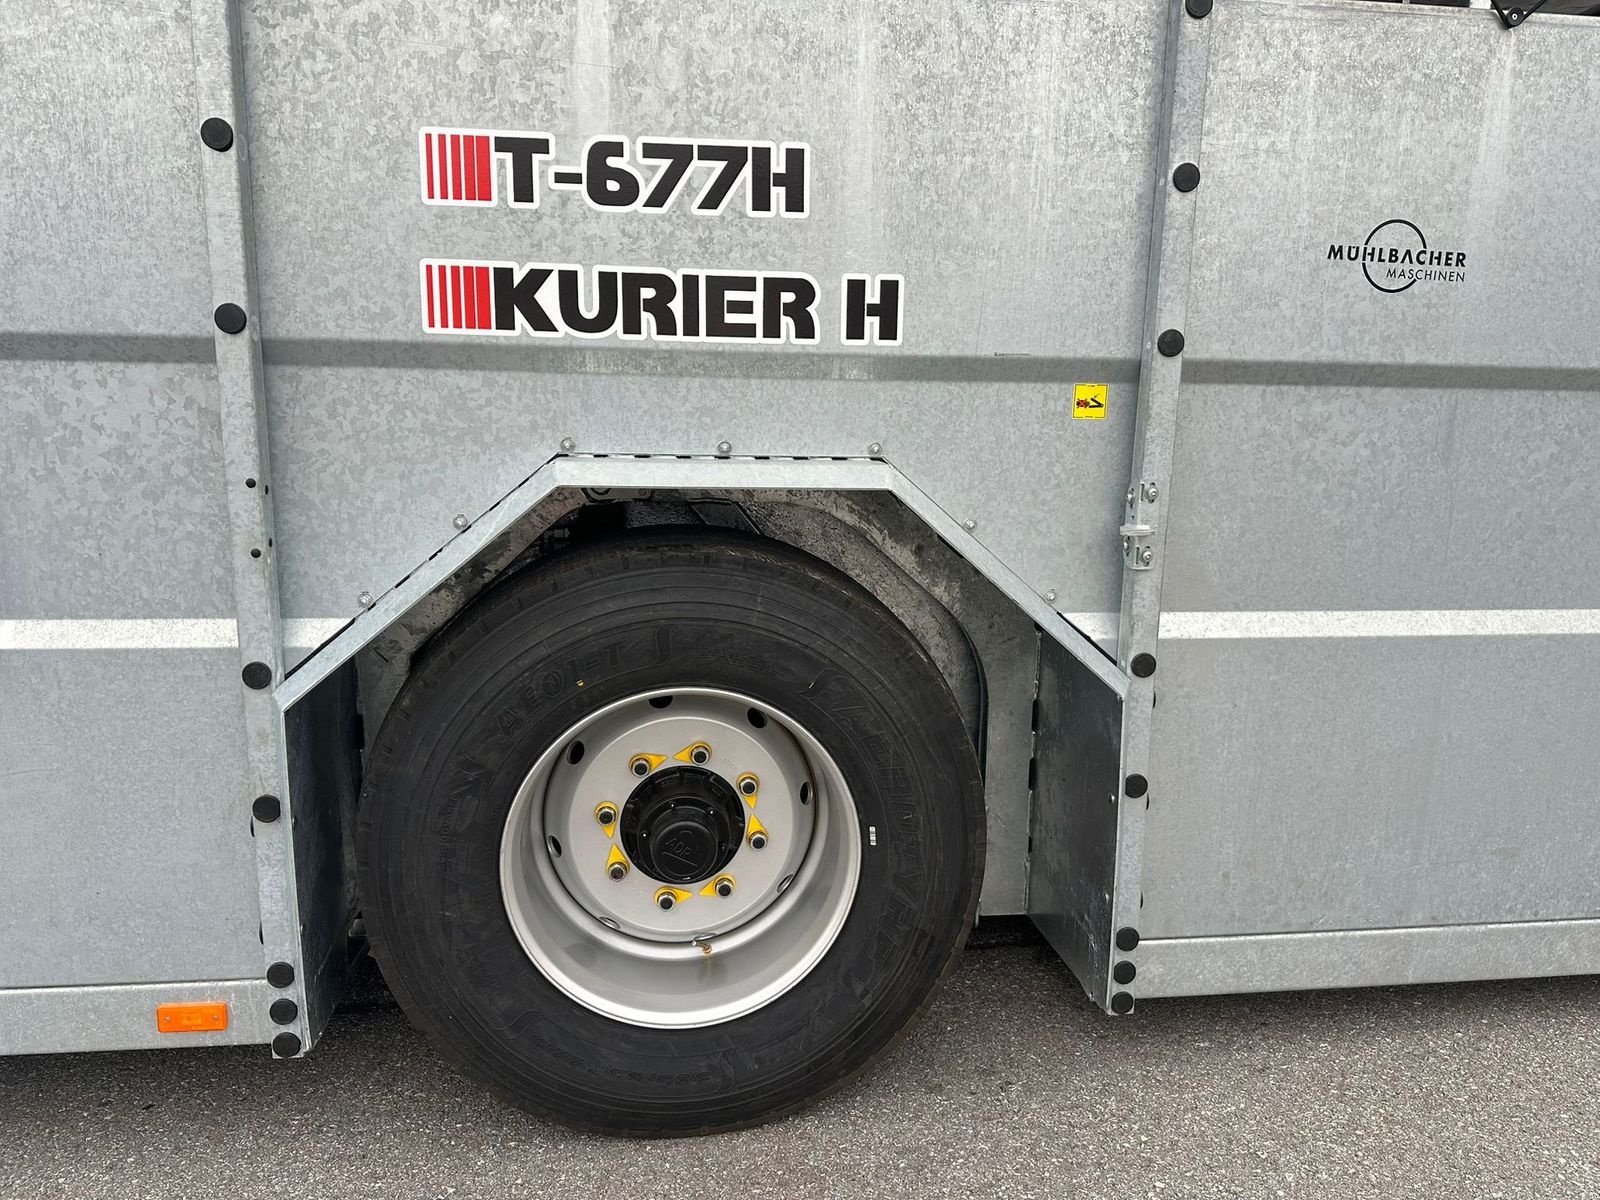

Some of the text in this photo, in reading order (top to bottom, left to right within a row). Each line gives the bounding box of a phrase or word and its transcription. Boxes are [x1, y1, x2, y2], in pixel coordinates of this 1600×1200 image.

[494, 136, 805, 213] T-677H
[1327, 244, 1467, 267] MÜHLBACHER
[1386, 268, 1466, 283] MASCHINEN
[493, 266, 900, 341] KURIER H
